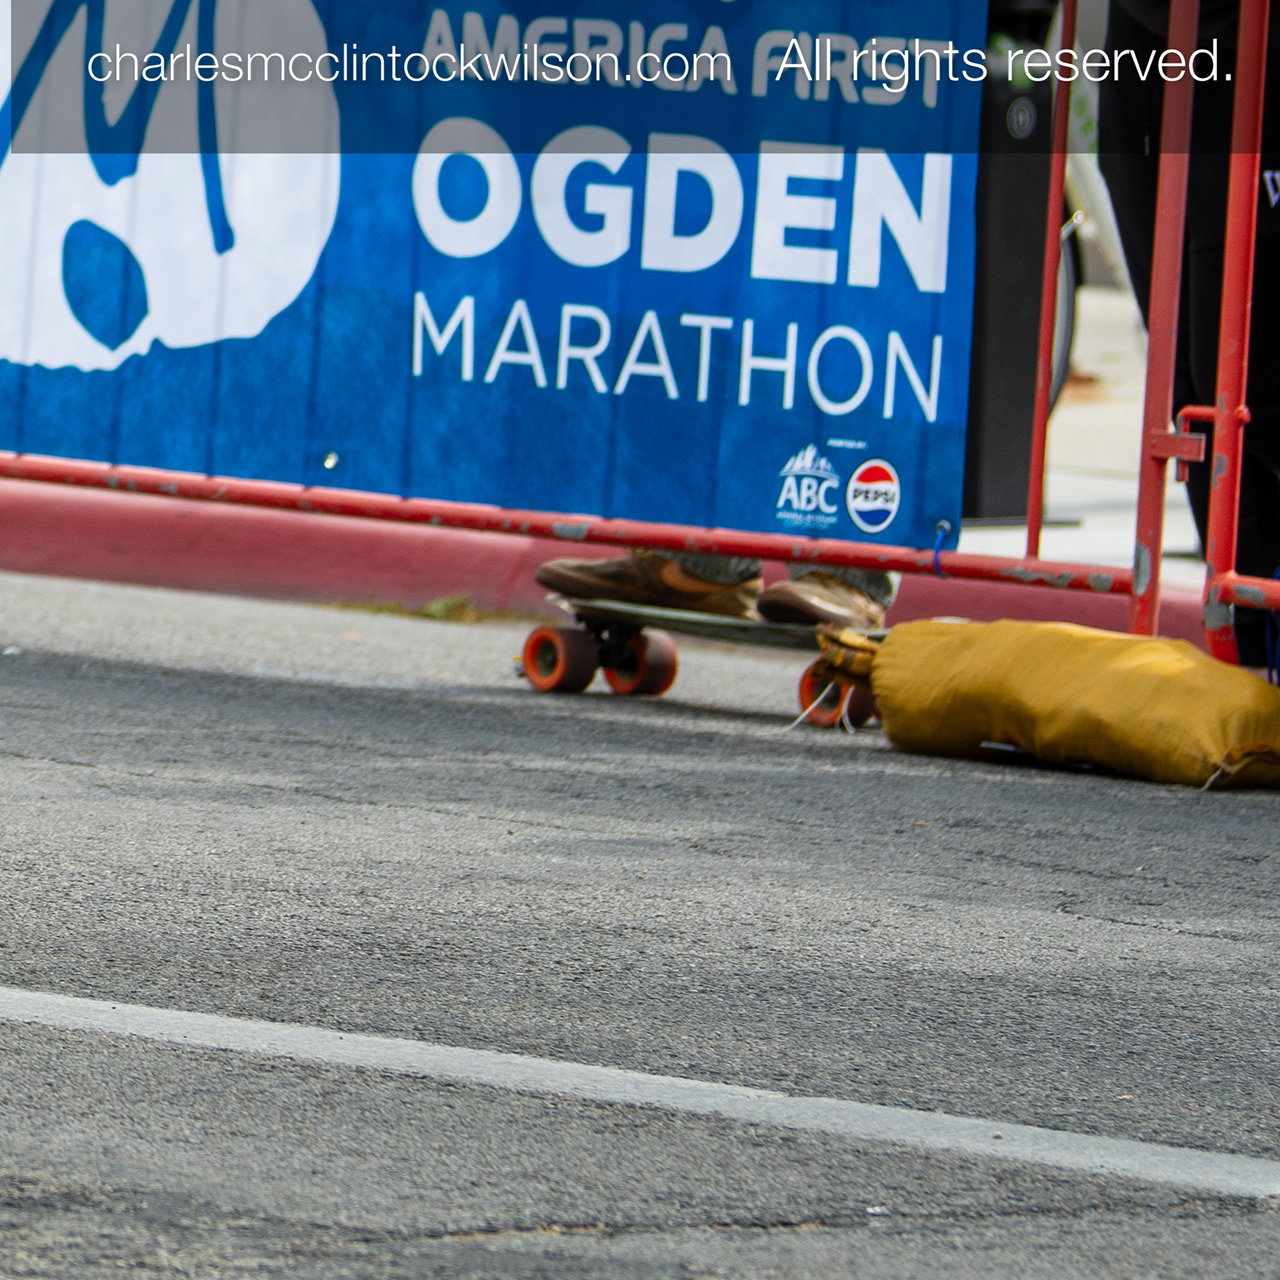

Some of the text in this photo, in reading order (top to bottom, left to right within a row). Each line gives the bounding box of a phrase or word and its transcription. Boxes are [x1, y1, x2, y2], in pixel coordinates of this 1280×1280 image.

[421, 8, 940, 109] AMERICA FIRST
[412, 116, 953, 294] OGDEN
[412, 291, 943, 423] MARATHON
[776, 476, 839, 514] ABC
[853, 487, 896, 505] PEPSI
